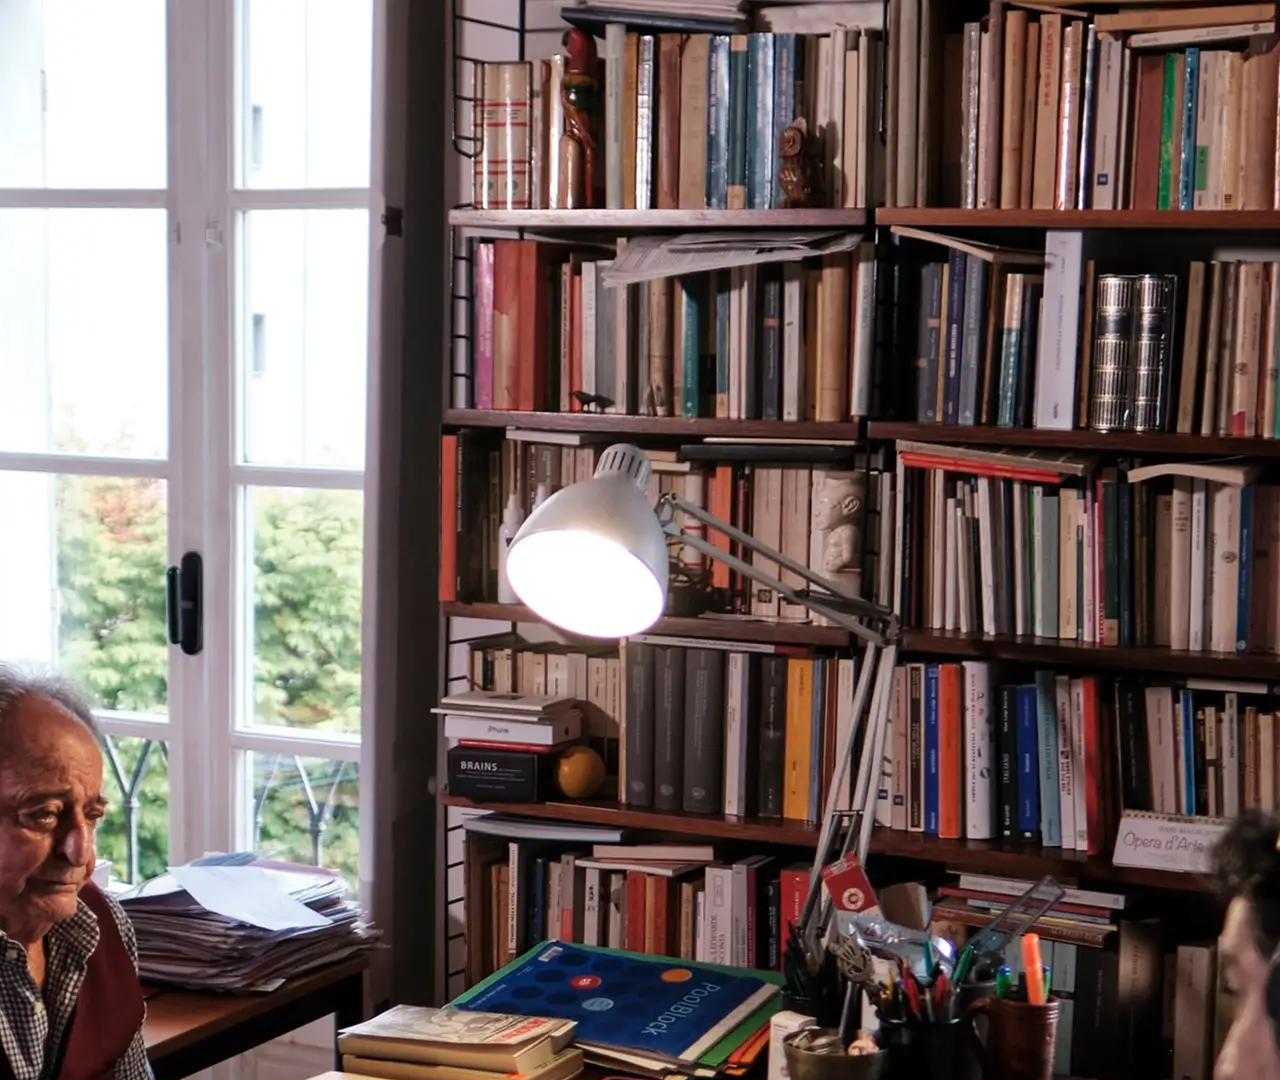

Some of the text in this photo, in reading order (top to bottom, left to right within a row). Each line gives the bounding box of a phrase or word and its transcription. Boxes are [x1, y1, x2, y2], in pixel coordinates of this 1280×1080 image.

[488, 726, 510, 734] iPhone
[460, 760, 498, 772] BRAINS
[1123, 830, 1162, 852] Opera
